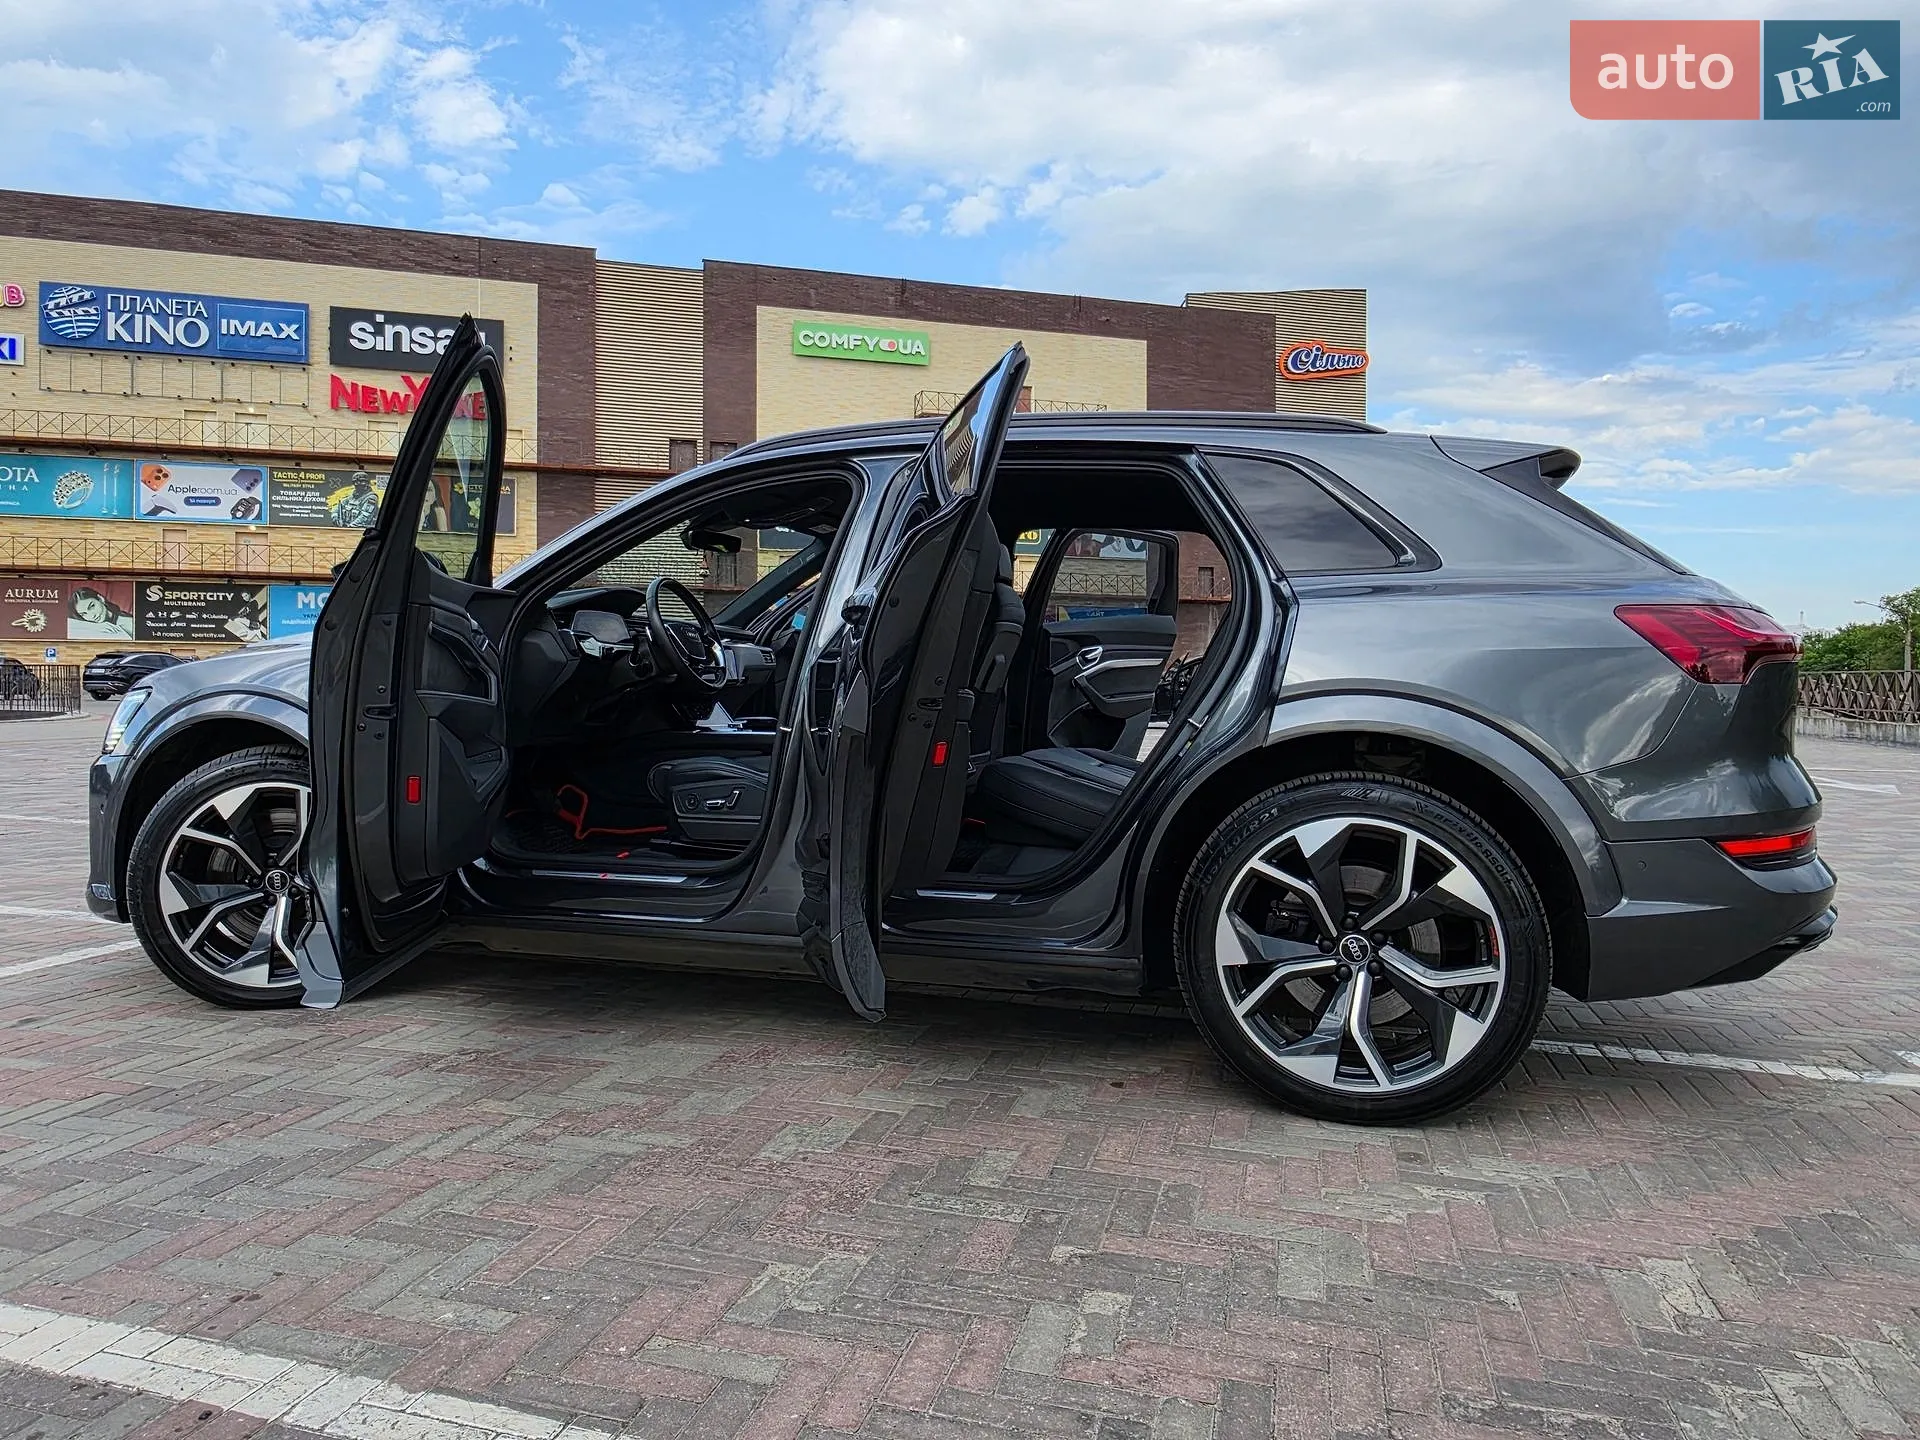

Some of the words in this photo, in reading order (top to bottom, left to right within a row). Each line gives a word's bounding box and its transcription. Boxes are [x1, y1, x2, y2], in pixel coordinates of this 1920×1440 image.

[0, 284, 25, 307] B
[107, 312, 209, 348] KINO
[221, 319, 300, 340] IMAX
[350, 314, 486, 355] sinsa
[1287, 345, 1366, 373] Сільпо
[299, 471, 305, 480] 4
[306, 473, 326, 481] PROFI
[168, 484, 238, 496] Appleroom.ua
[5, 588, 59, 599] AURUM
[164, 591, 235, 601] SPORTCITY
